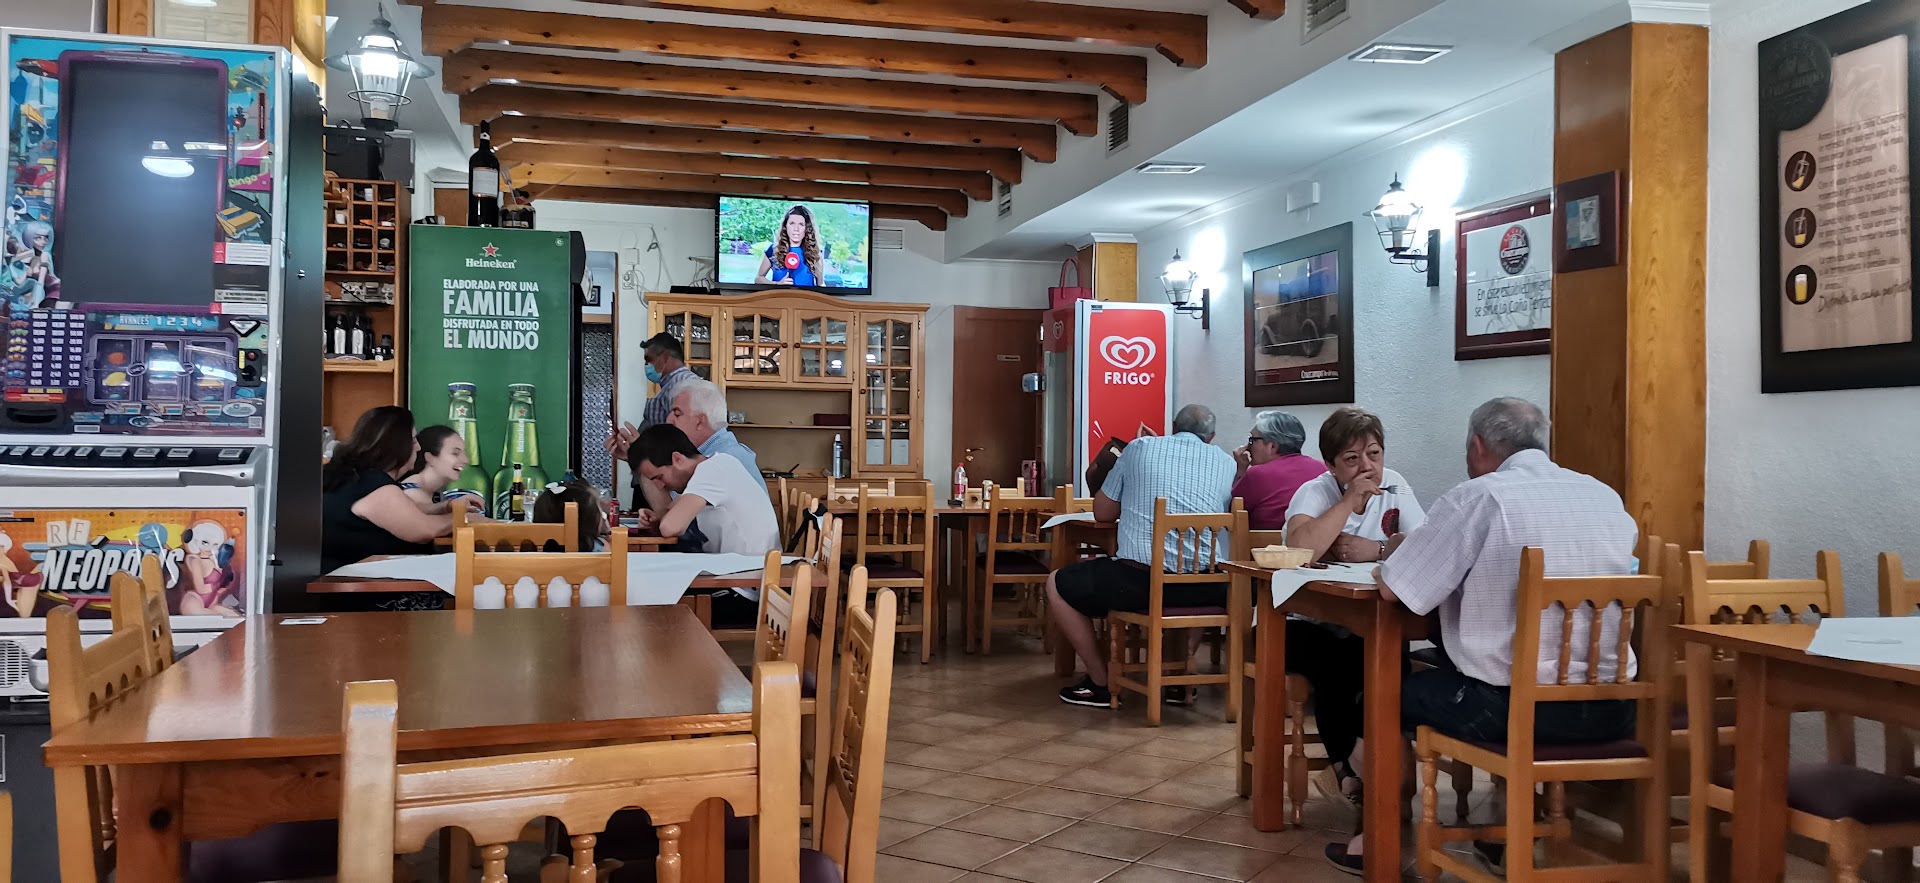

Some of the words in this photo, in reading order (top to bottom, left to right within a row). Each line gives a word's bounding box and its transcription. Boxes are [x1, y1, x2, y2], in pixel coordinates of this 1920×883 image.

[465, 258, 516, 269] Heineken
[443, 279, 496, 290] ELABORADA
[498, 280, 517, 291] POR
[520, 281, 539, 292] UNA
[443, 290, 540, 317] FAMILIA
[166, 316, 177, 326] 2
[180, 316, 189, 326] 3
[191, 317, 203, 327] 4
[443, 318, 499, 330] DISFRUTADA
[500, 320, 513, 330] EN
[514, 320, 540, 331] TODO
[443, 328, 463, 349] EL
[467, 330, 539, 350] MUNDO
[1104, 371, 1151, 386] FRIGO
